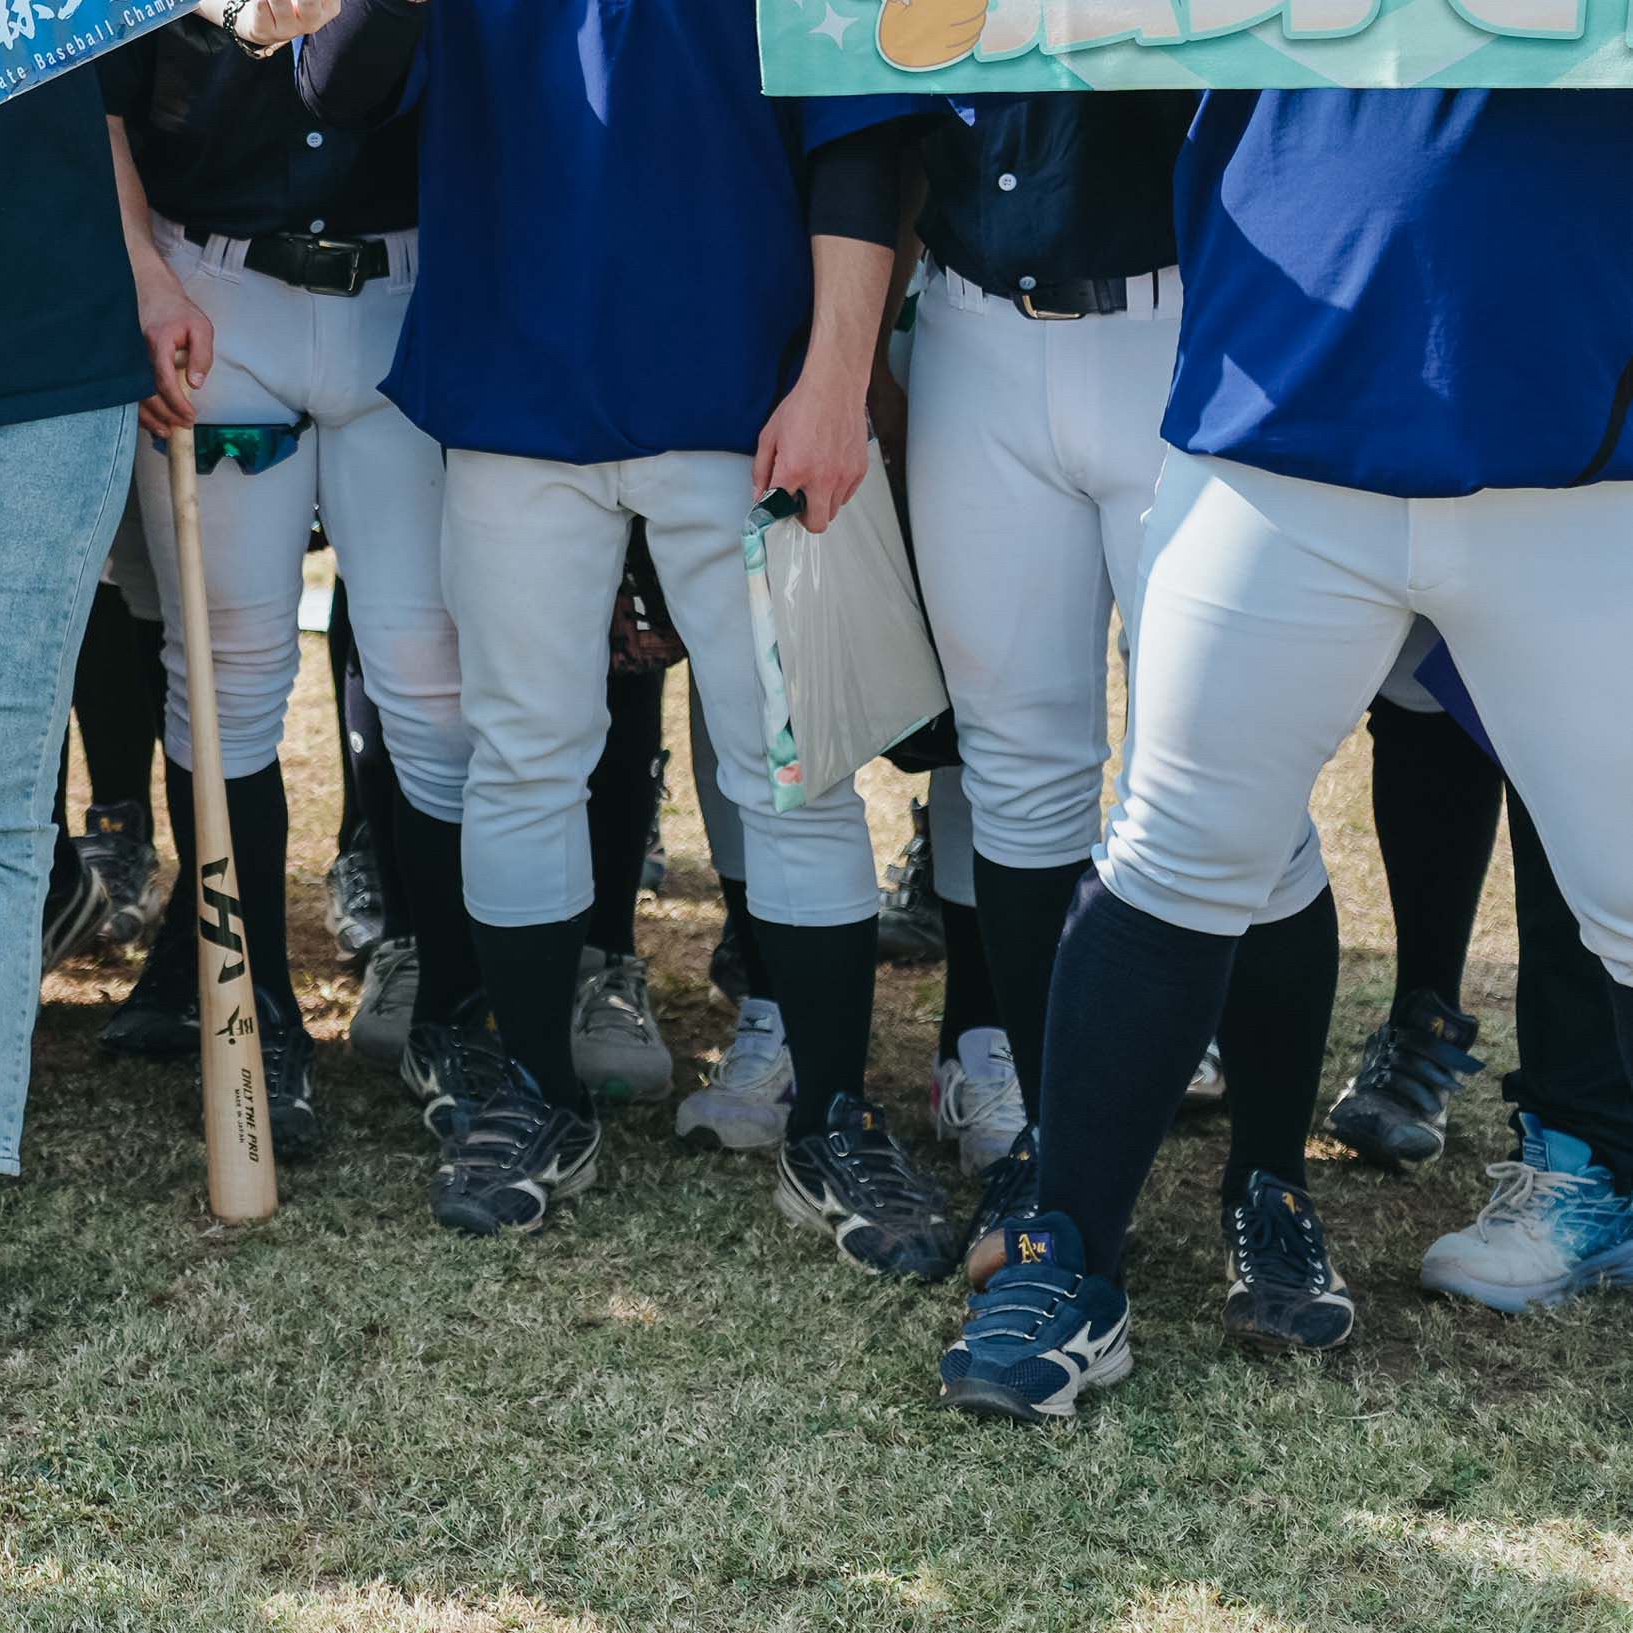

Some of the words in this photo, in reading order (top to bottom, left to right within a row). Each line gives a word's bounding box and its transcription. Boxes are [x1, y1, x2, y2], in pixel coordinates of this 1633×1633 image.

[33, 18, 115, 69] Baseball
[240, 1067, 254, 1103] ONLY
[245, 1105, 256, 1130] THE
[248, 1133, 259, 1162] PRO
